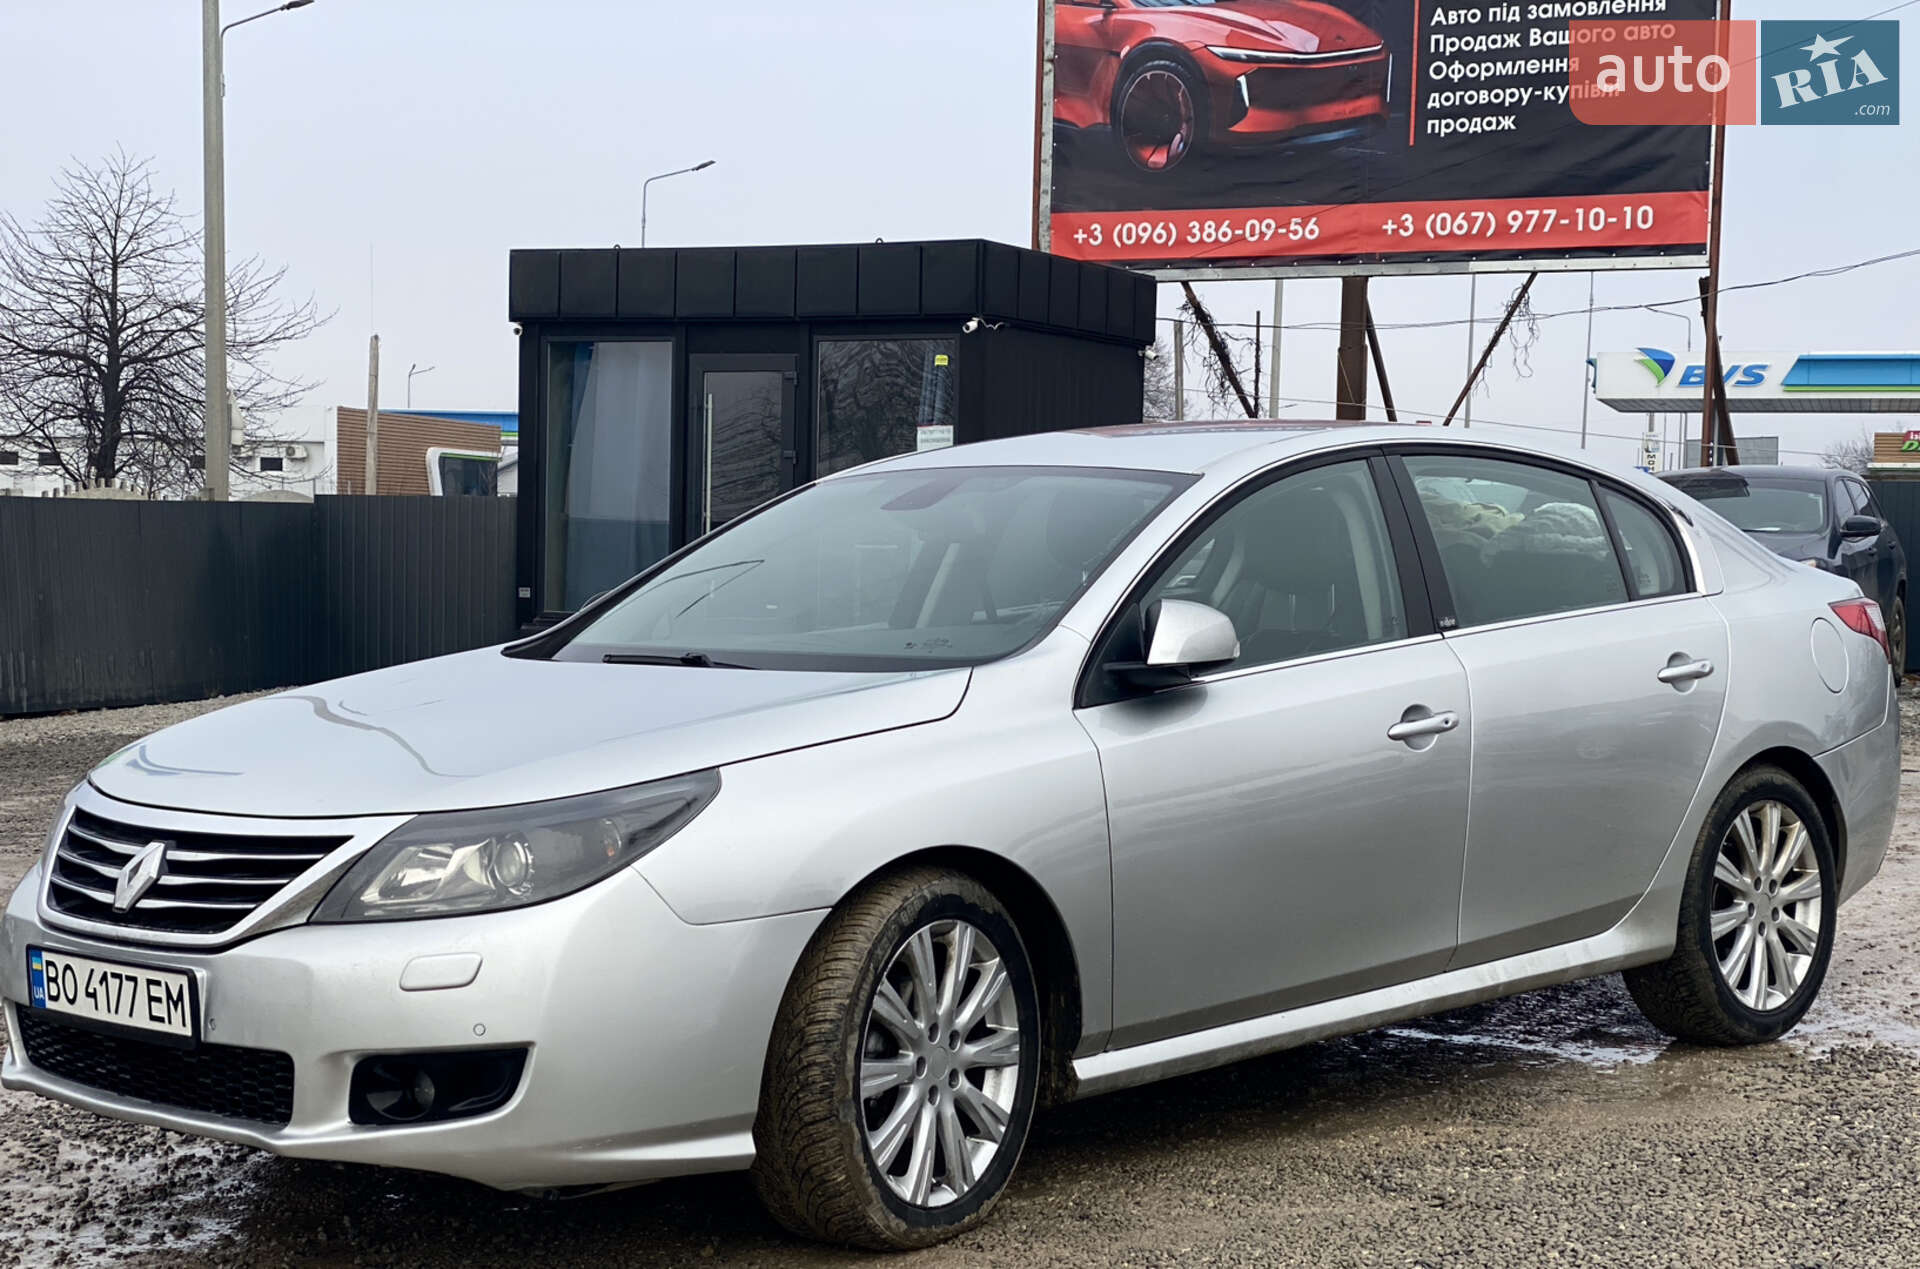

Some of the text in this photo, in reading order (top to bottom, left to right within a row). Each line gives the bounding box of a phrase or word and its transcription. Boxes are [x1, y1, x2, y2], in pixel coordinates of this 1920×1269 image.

[1430, 0, 1667, 26] Авто під замовлення
[1430, 23, 1677, 55] Продаж Вашого авто
[1429, 56, 1580, 82] Оформлення
[1427, 113, 1517, 137] продаж
[1073, 217, 1320, 248] +3 (096) 386-09-56
[1382, 205, 1654, 240] +3 (067) 977-10-10
[33, 959, 187, 1028] UA BO 4177 EM
